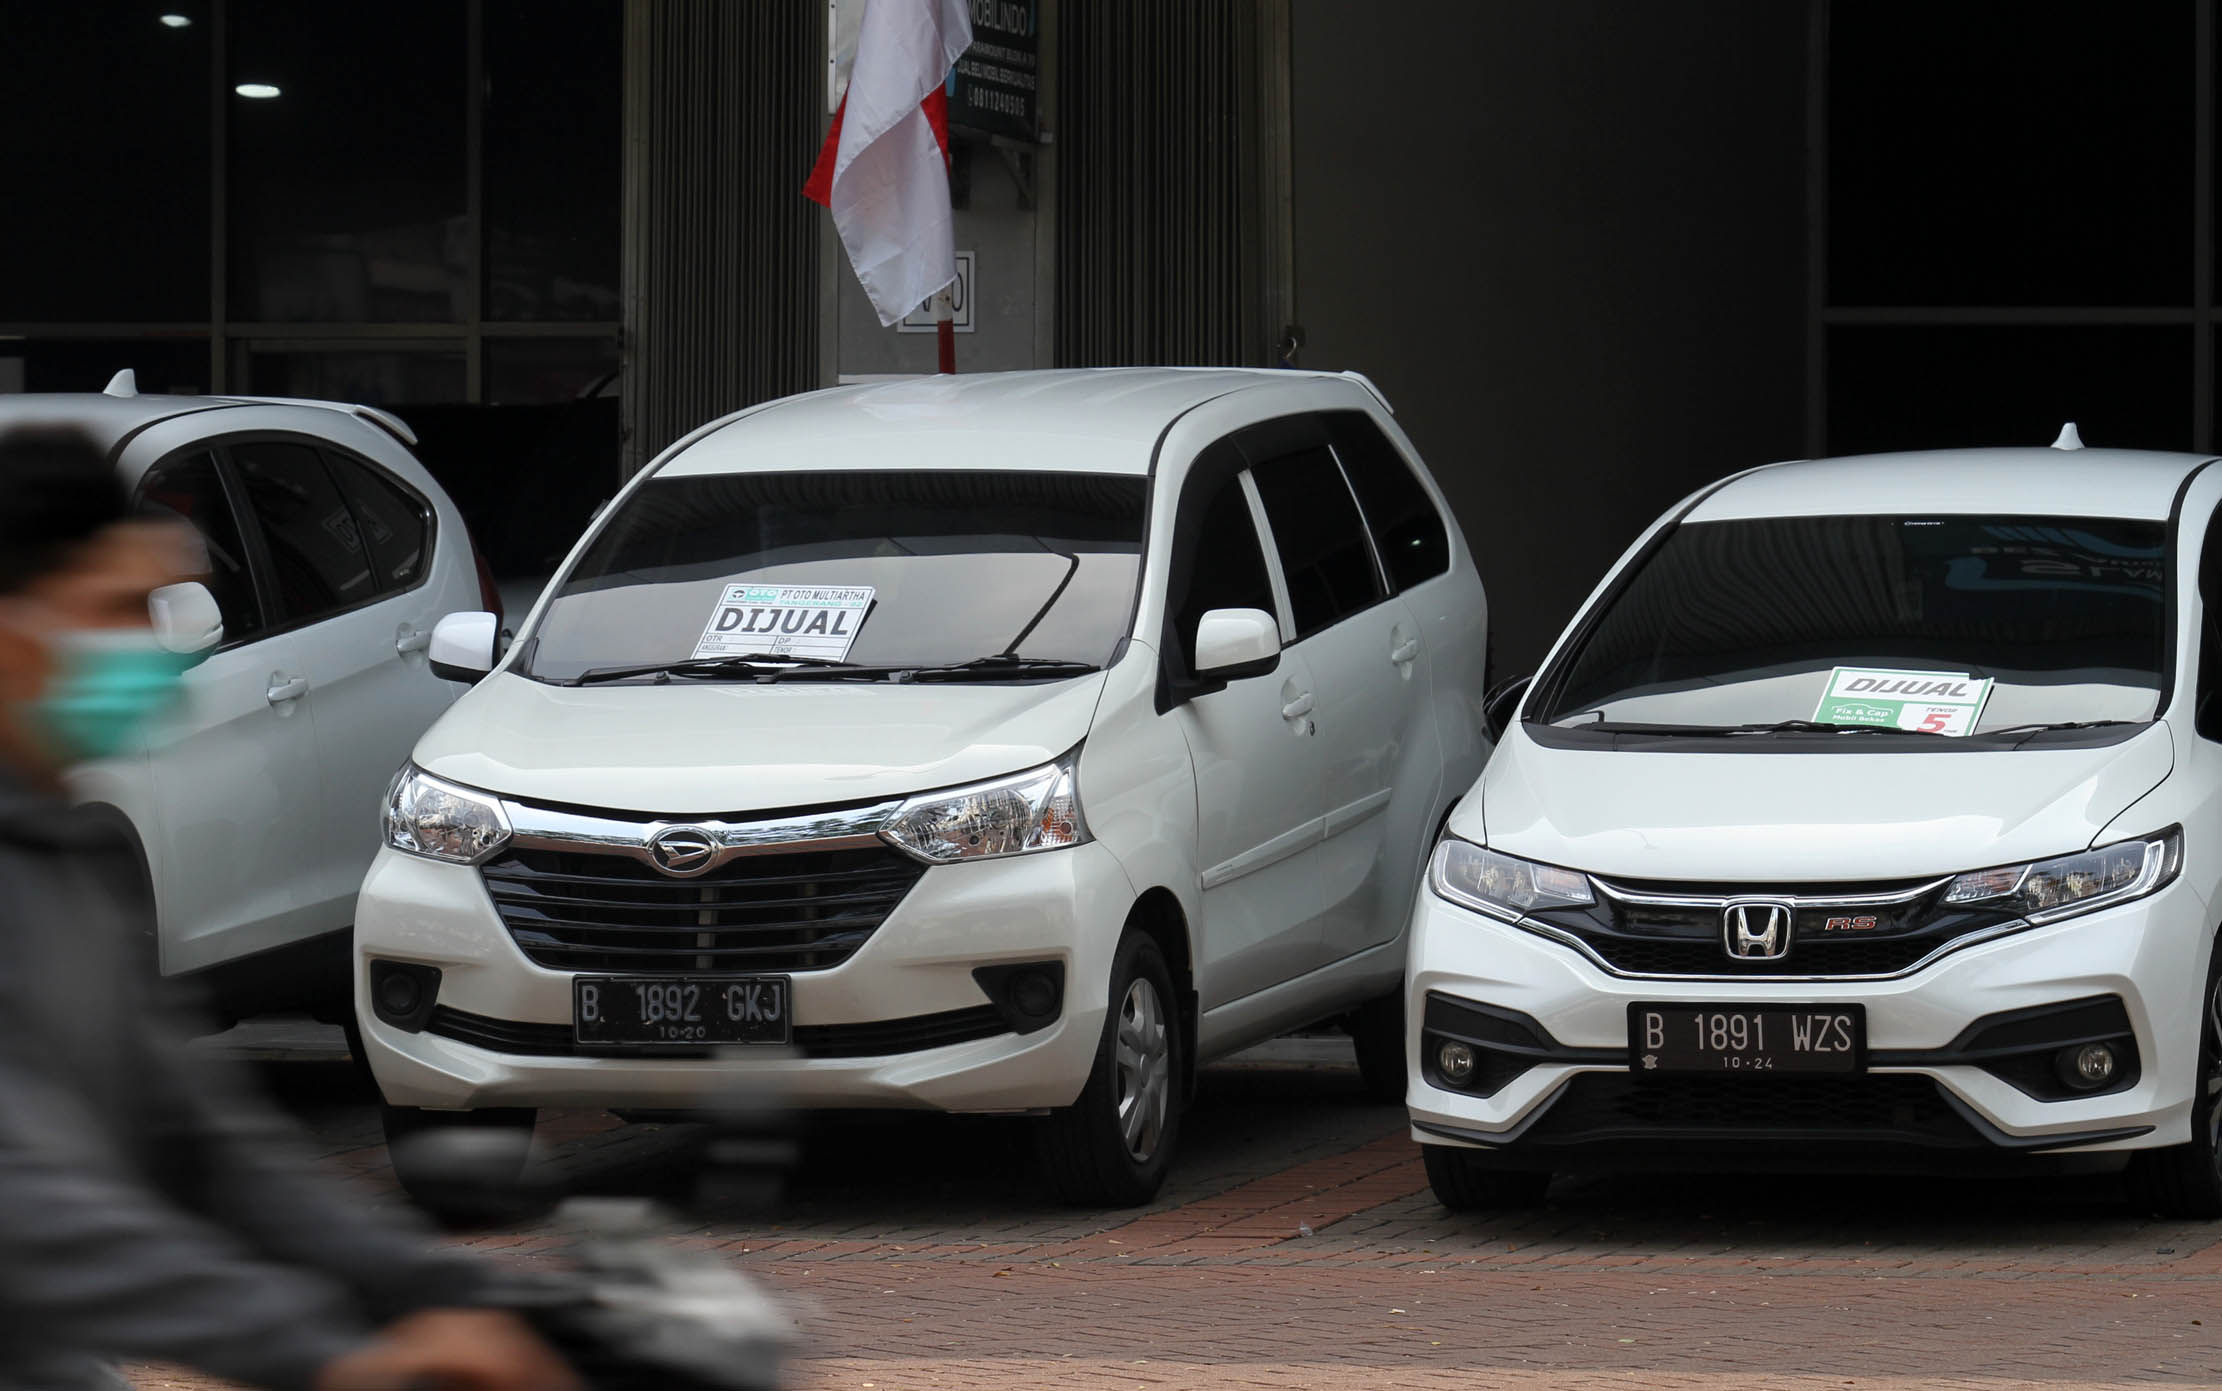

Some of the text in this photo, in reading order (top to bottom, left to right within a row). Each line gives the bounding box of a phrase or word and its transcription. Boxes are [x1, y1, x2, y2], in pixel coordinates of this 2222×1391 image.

[781, 589, 866, 601] PT OTO MULTIARTHA
[715, 607, 849, 636] DIJUAL
[778, 637, 791, 645] DP
[1845, 678, 1967, 697] DIJUAL
[1867, 709, 1889, 717] Cap
[1916, 714, 1951, 733] 5
[1824, 915, 1878, 931] RS
[581, 983, 782, 1023] B 1892 GKJ
[1645, 1011, 1853, 1053] B 1891 WZS
